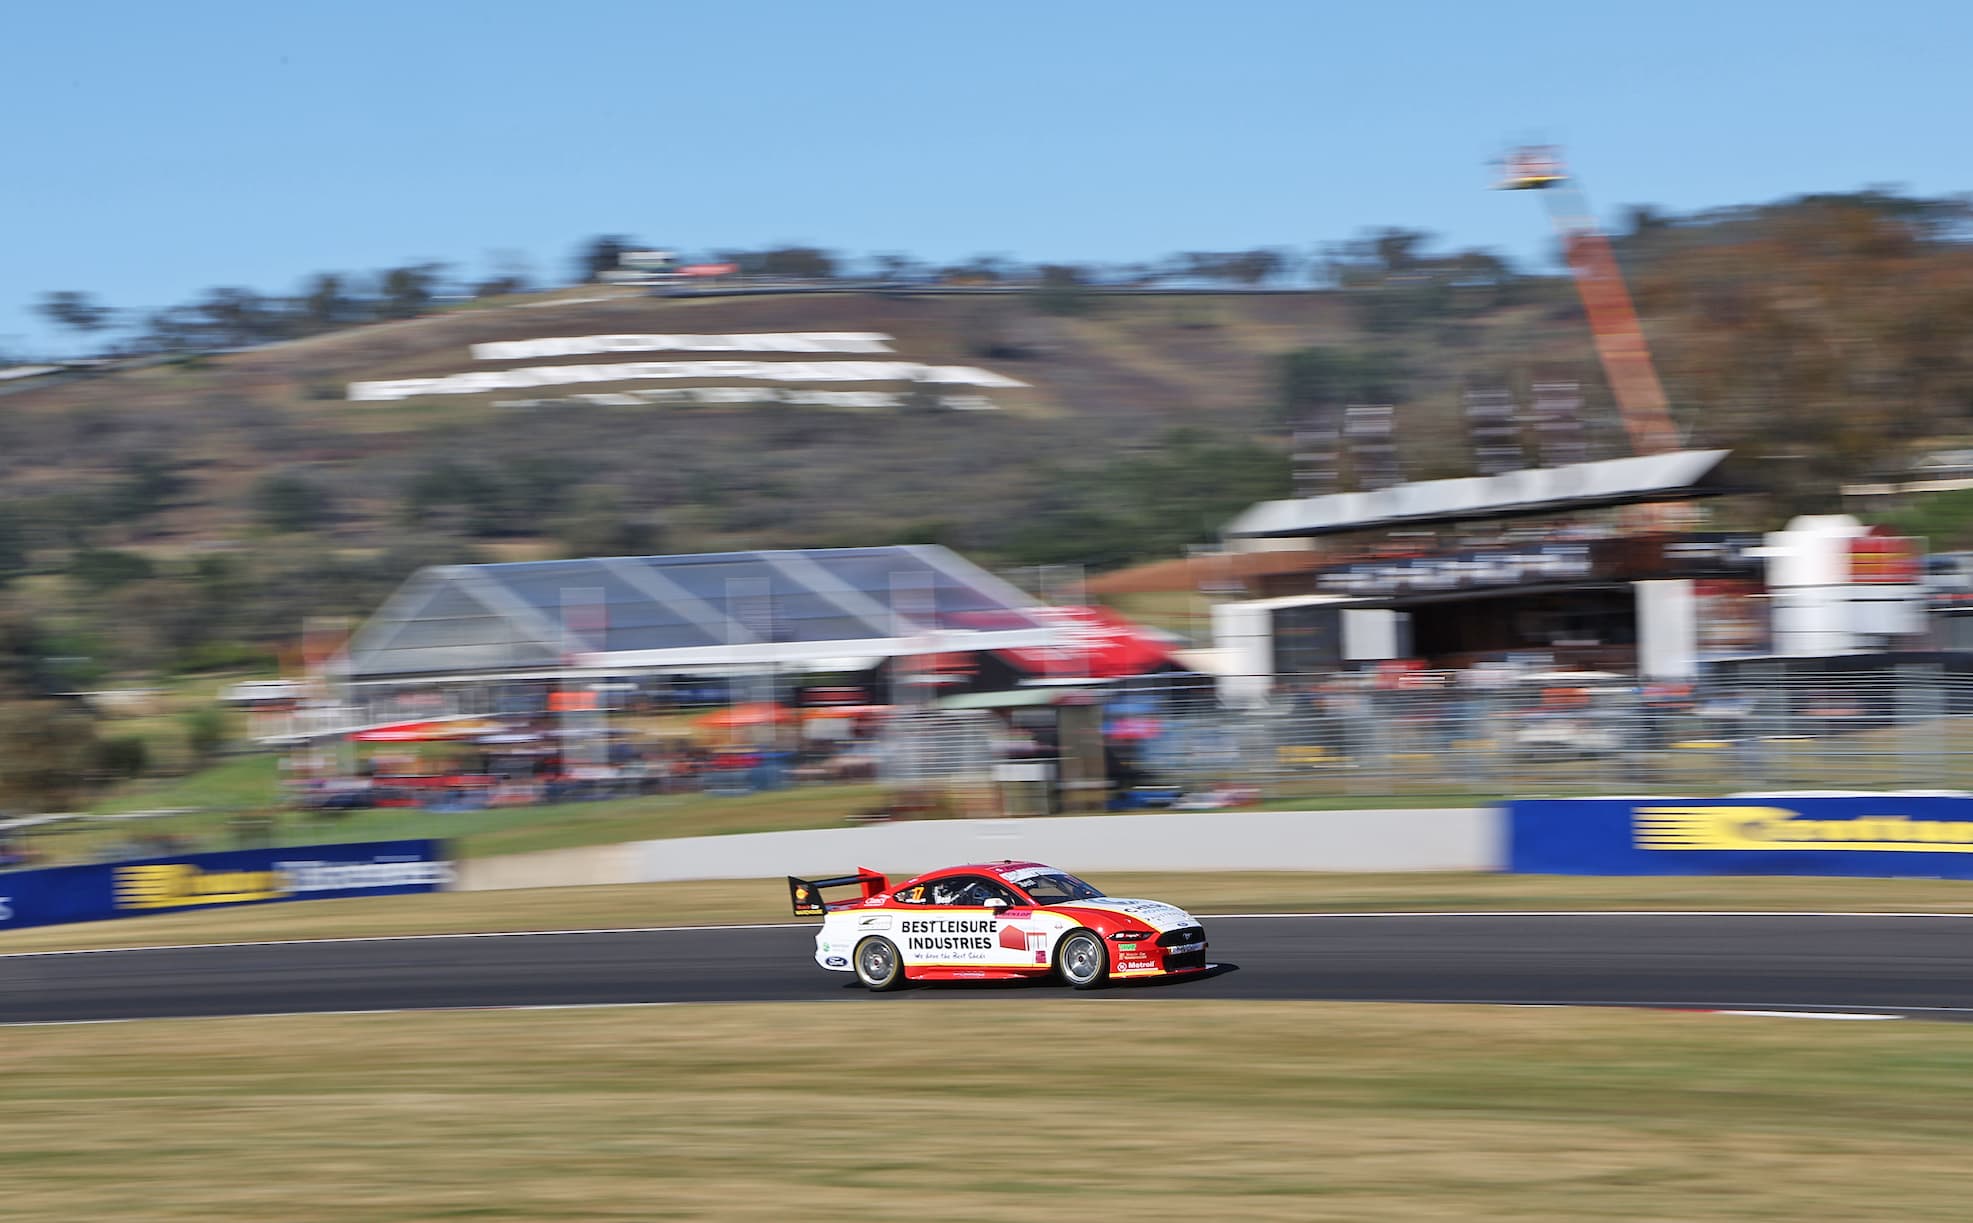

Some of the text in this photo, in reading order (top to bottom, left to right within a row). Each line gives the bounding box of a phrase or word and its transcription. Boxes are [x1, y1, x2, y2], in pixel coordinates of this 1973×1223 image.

[911, 886, 925, 901] 17
[902, 920, 998, 933] BEST LEISURE
[908, 937, 992, 950] INDUSTRIES
